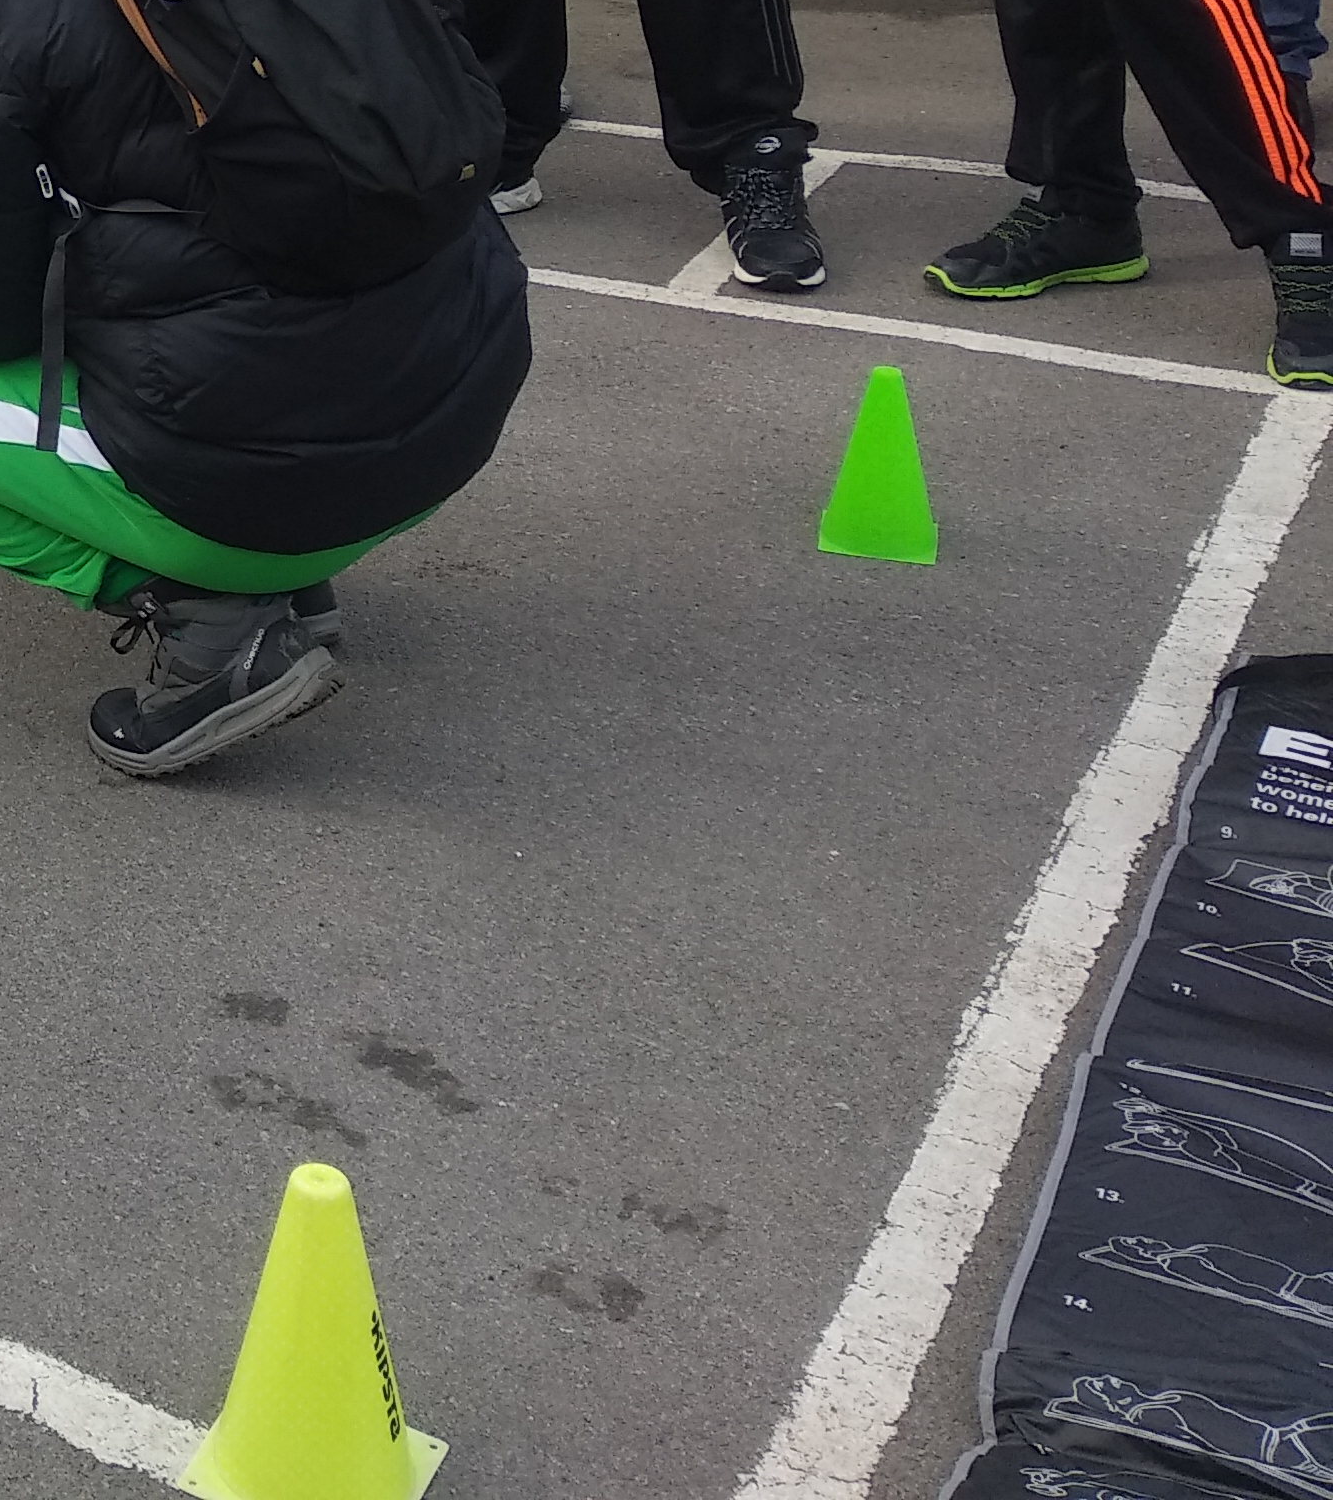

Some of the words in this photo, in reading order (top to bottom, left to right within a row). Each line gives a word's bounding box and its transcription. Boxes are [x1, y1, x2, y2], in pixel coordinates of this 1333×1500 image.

[1250, 797, 1278, 813] to
[1220, 825, 1238, 839] 9.
[1197, 901, 1222, 917] 10.
[1096, 1188, 1125, 1203] 13.
[1064, 1295, 1093, 1311] 14.
